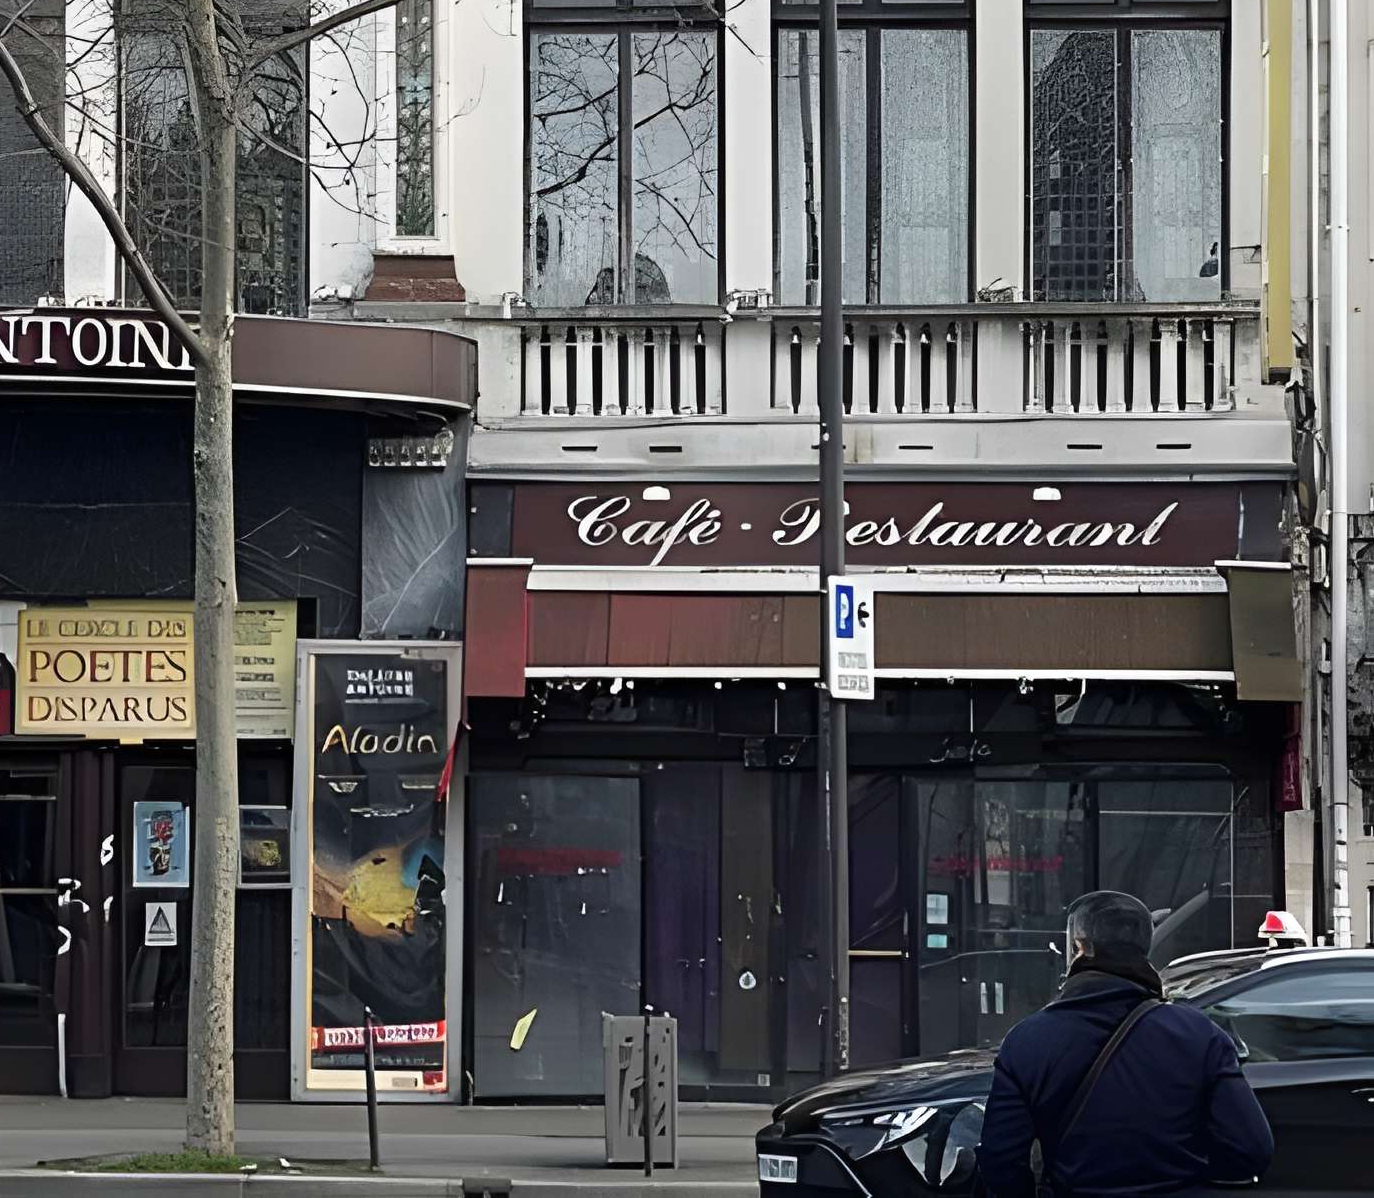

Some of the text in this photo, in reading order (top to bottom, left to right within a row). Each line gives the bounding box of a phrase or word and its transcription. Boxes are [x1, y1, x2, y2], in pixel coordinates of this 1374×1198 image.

[567, 495, 722, 567] Café
[28, 696, 187, 722] DISPARUS
[321, 723, 438, 755] Aladin
